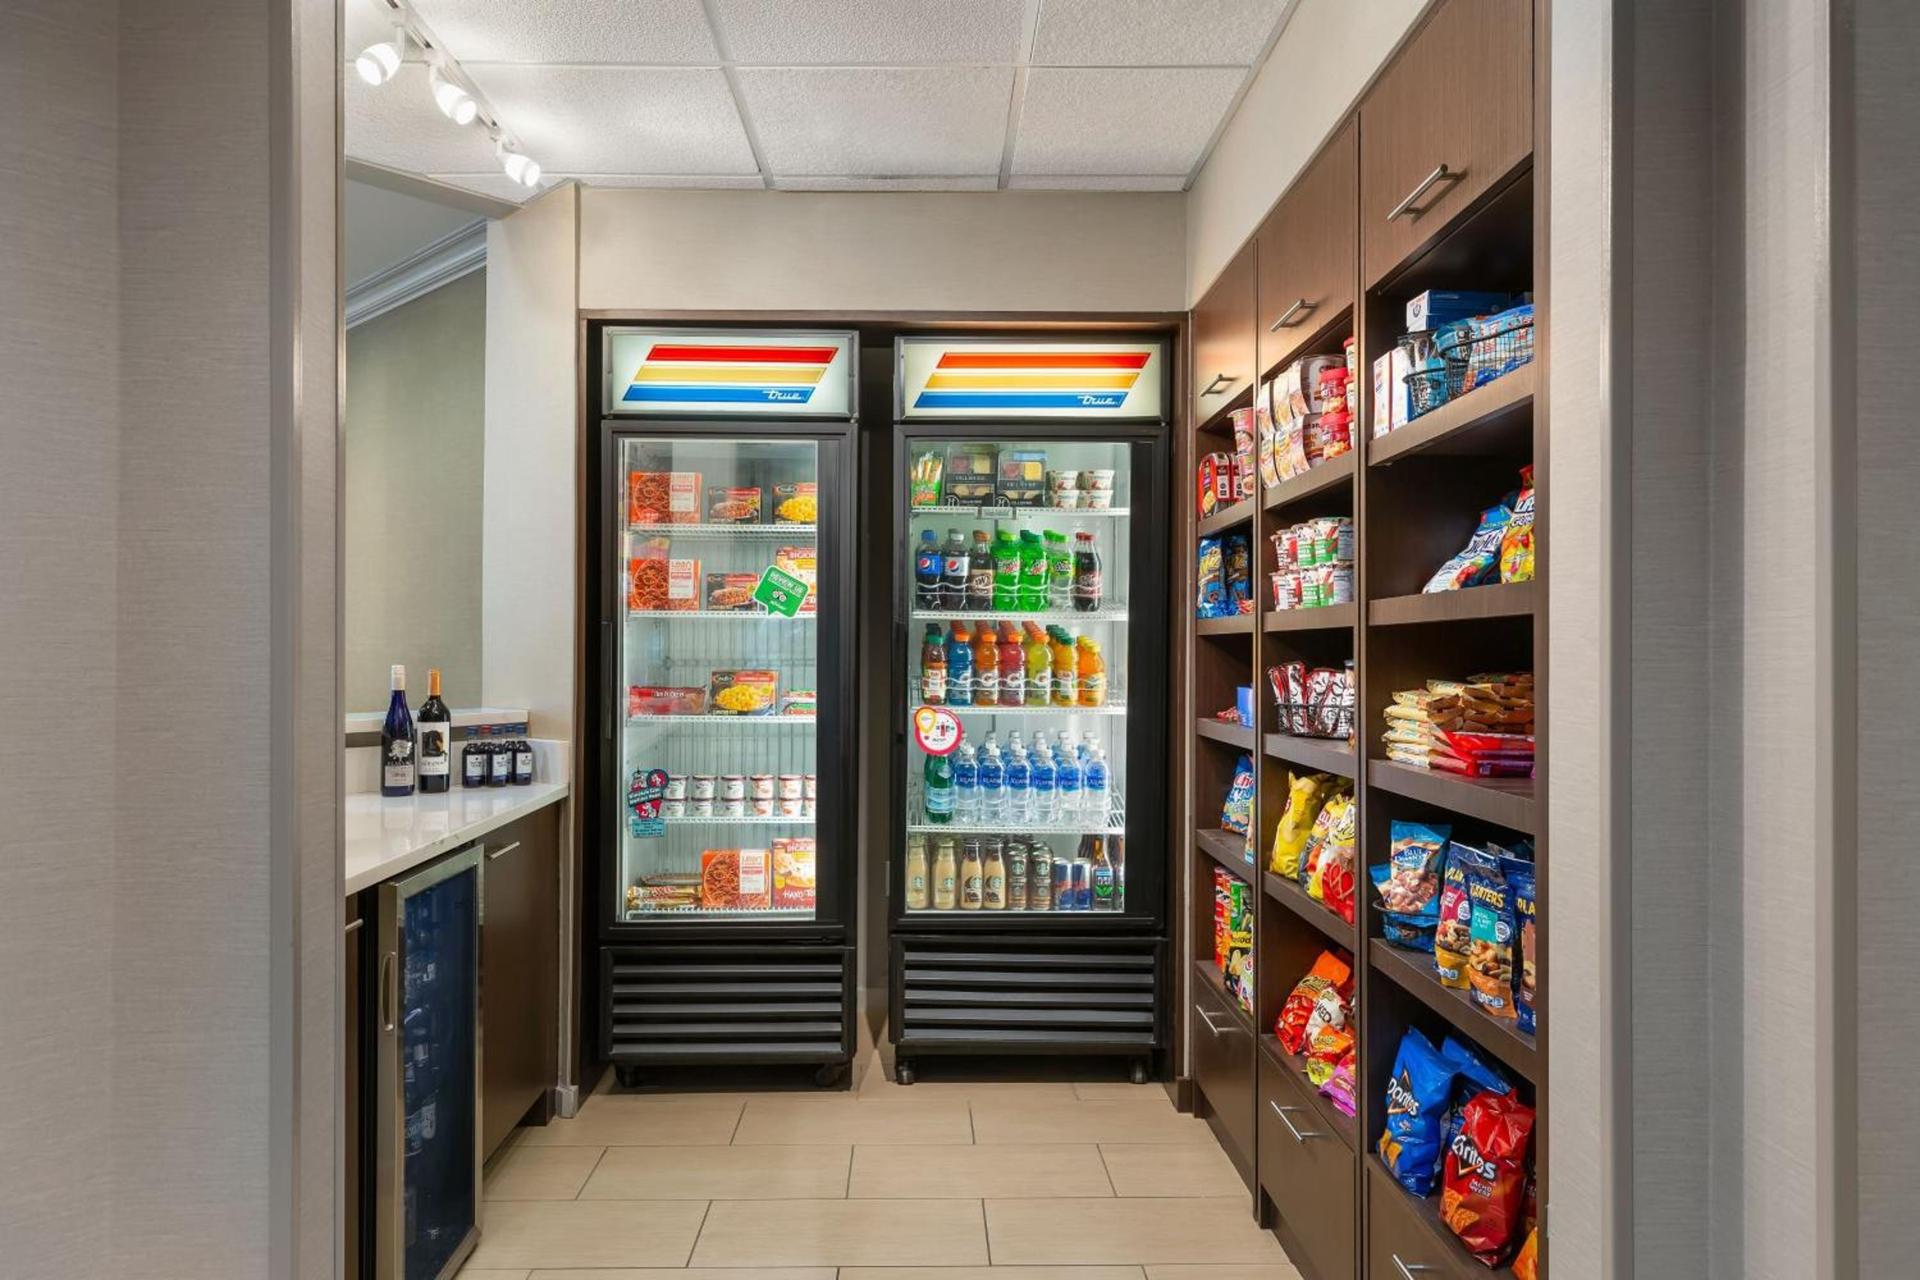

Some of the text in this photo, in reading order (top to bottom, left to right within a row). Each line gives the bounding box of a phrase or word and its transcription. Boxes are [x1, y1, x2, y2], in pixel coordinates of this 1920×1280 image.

[762, 390, 802, 400] True
[1077, 395, 1115, 405] True
[1387, 1078, 1419, 1115] Doritos
